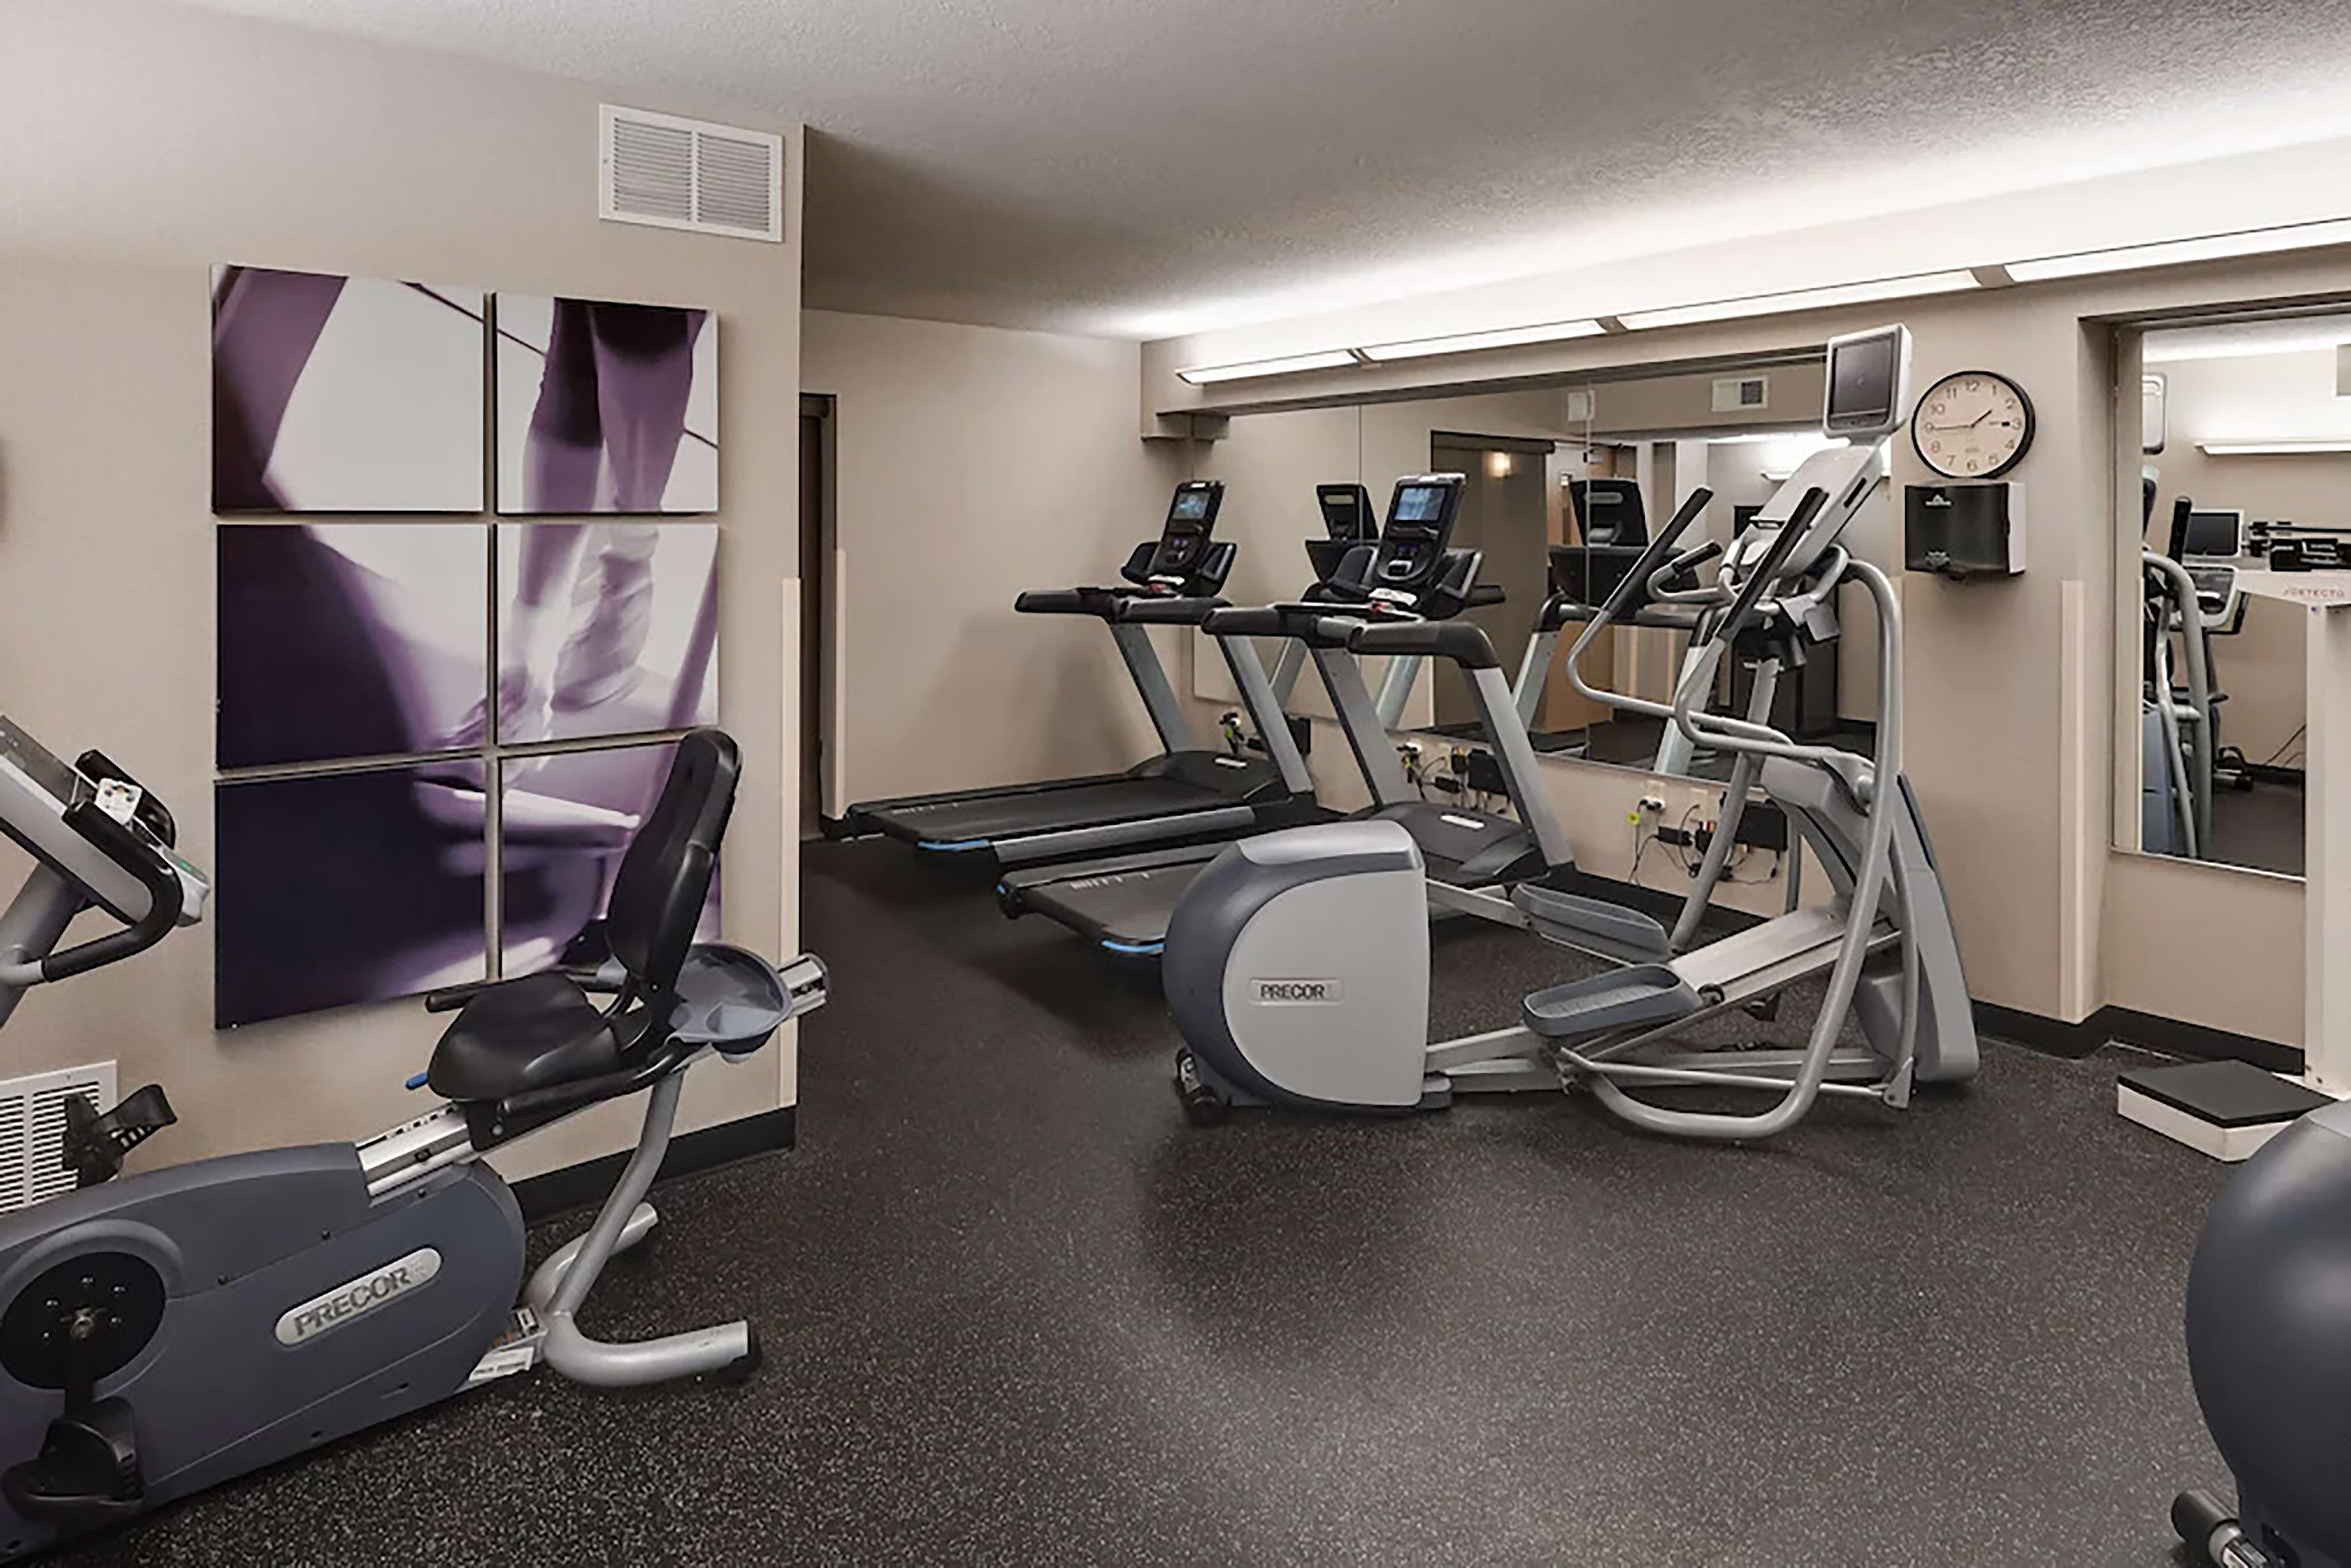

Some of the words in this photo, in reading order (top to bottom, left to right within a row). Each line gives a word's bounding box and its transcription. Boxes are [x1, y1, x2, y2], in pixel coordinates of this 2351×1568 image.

[1965, 380, 1980, 392] 12
[1946, 388, 1957, 399] 11
[1930, 403, 1946, 415] 10
[2005, 398, 2016, 409] 2
[2011, 417, 2022, 430] 3
[1931, 441, 1941, 453] 8
[2004, 440, 2015, 450] 4
[1946, 455, 1956, 467] 7
[1966, 460, 1978, 471] 6
[1988, 454, 1999, 466] 5
[1260, 984, 1325, 1001] PRECOR
[294, 1267, 412, 1337] PRECOR
